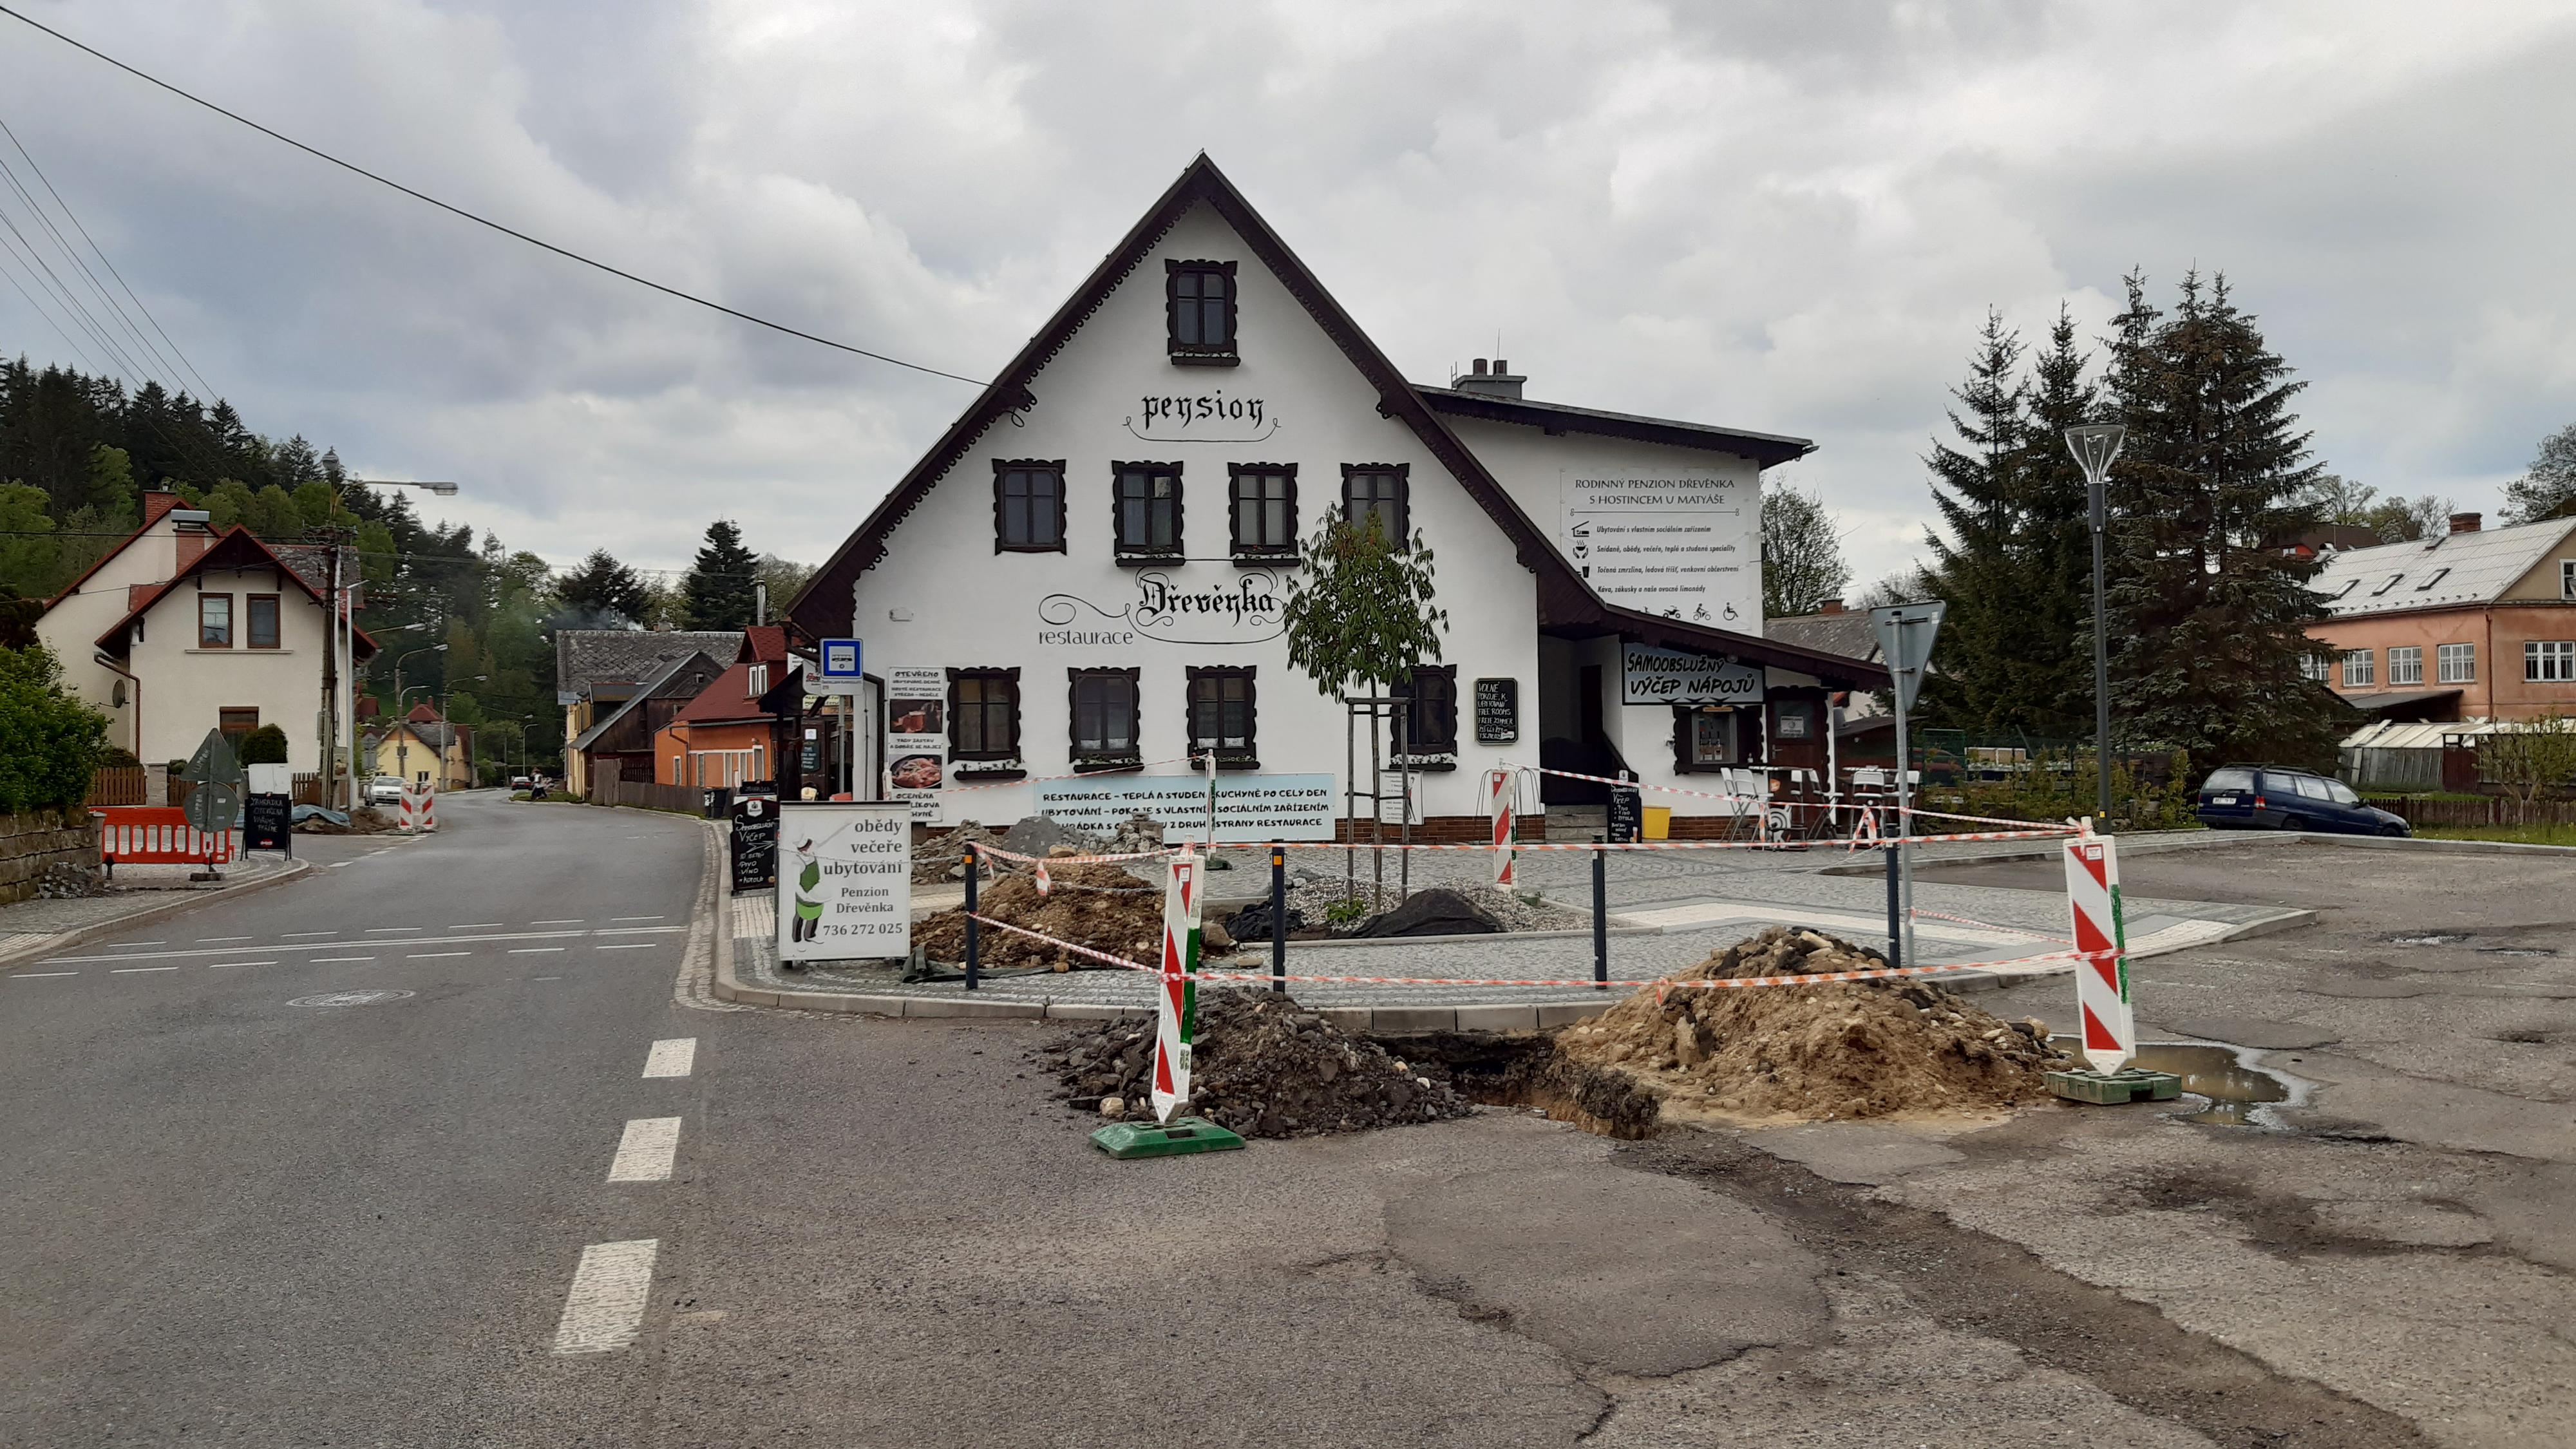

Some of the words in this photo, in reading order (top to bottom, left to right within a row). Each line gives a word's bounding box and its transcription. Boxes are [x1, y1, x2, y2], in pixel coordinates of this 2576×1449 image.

[1141, 389, 1264, 430] pension
[1575, 478, 1625, 488] RODINNÝ
[1628, 479, 1675, 488] PENZION
[1679, 478, 1735, 488] DŘEVĚNKA
[1589, 495, 1595, 504] S
[1598, 495, 1663, 504] HOSTINCEM
[1665, 495, 1674, 504] U
[1677, 493, 1725, 504] MATYÁŠE
[1596, 525, 1626, 534] Ubytování
[1139, 578, 1276, 627] Dřevěnka
[1039, 630, 1134, 645] restaurace
[1627, 652, 1725, 674] SAMOOBSLUŽNÝ
[1631, 675, 1681, 696] VÝČEP
[1687, 673, 1755, 694] NÁPOJŮ
[1043, 793, 1112, 801] RESTAURACE
[1122, 790, 1155, 800] TEPLÁ
[1166, 791, 1207, 799] STUDEN
[1279, 788, 1305, 797] CELÝ
[1041, 806, 1102, 816] UBYTOVÁNÍ
[1163, 804, 1207, 814] VLASTNÍ
[1217, 803, 1272, 813] SOCIÁLNÍM
[1274, 802, 1329, 812] ZAŘÍZENÍM
[855, 819, 903, 835] obědy
[1056, 821, 1104, 830] HRÁDKA
[1216, 820, 1255, 828] STRANY
[1257, 819, 1323, 828] RESTAURACE
[851, 840, 902, 853] večeře
[823, 860, 903, 878] ubytování
[841, 887, 889, 898] Penzion
[836, 902, 894, 913] Dřevěnka
[823, 925, 848, 936] 736
[851, 923, 875, 935] 272
[878, 923, 903, 934] 025
